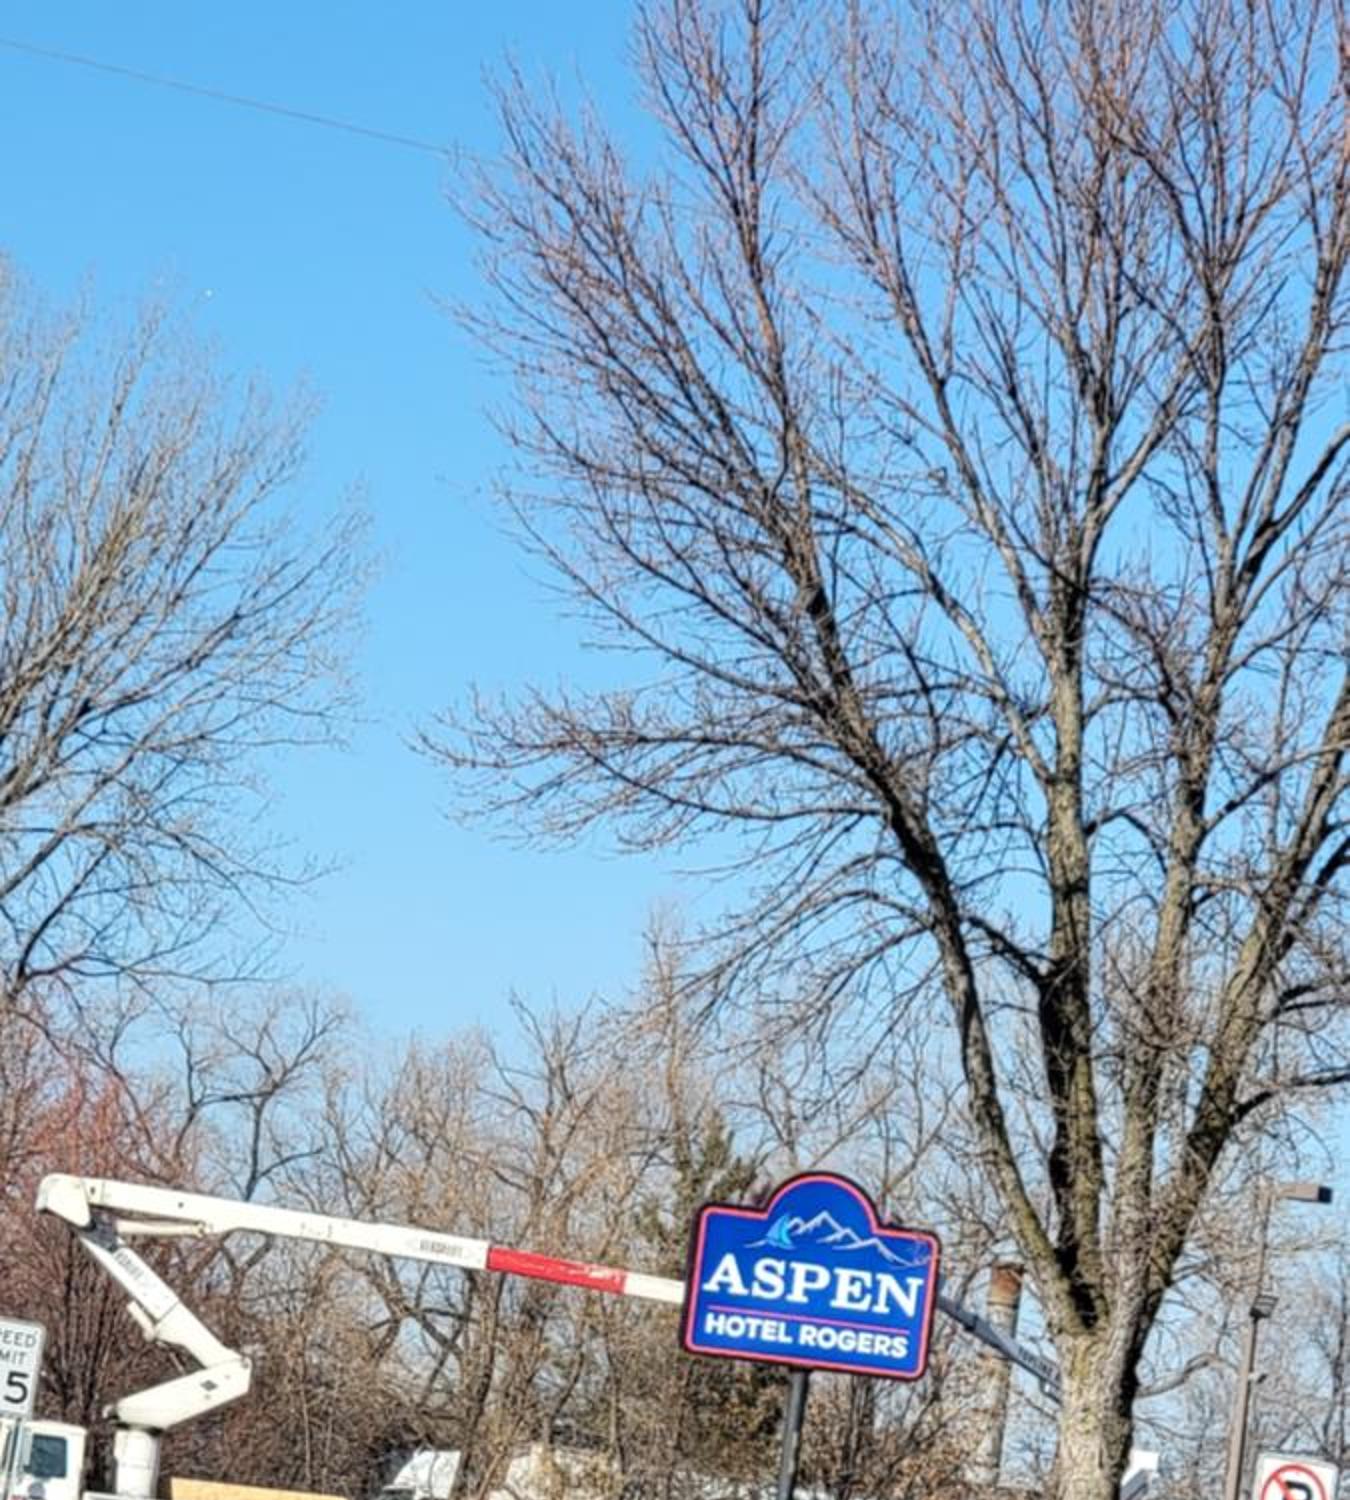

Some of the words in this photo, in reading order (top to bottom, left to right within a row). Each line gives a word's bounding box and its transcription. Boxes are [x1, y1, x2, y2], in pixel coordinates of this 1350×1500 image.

[702, 1252, 924, 1317] ASPEN
[0, 1327, 37, 1349] EED
[704, 1312, 793, 1344] HOTEL
[799, 1324, 910, 1359] ROGERS
[0, 1349, 26, 1366] MIT
[3, 1370, 29, 1404] 5
